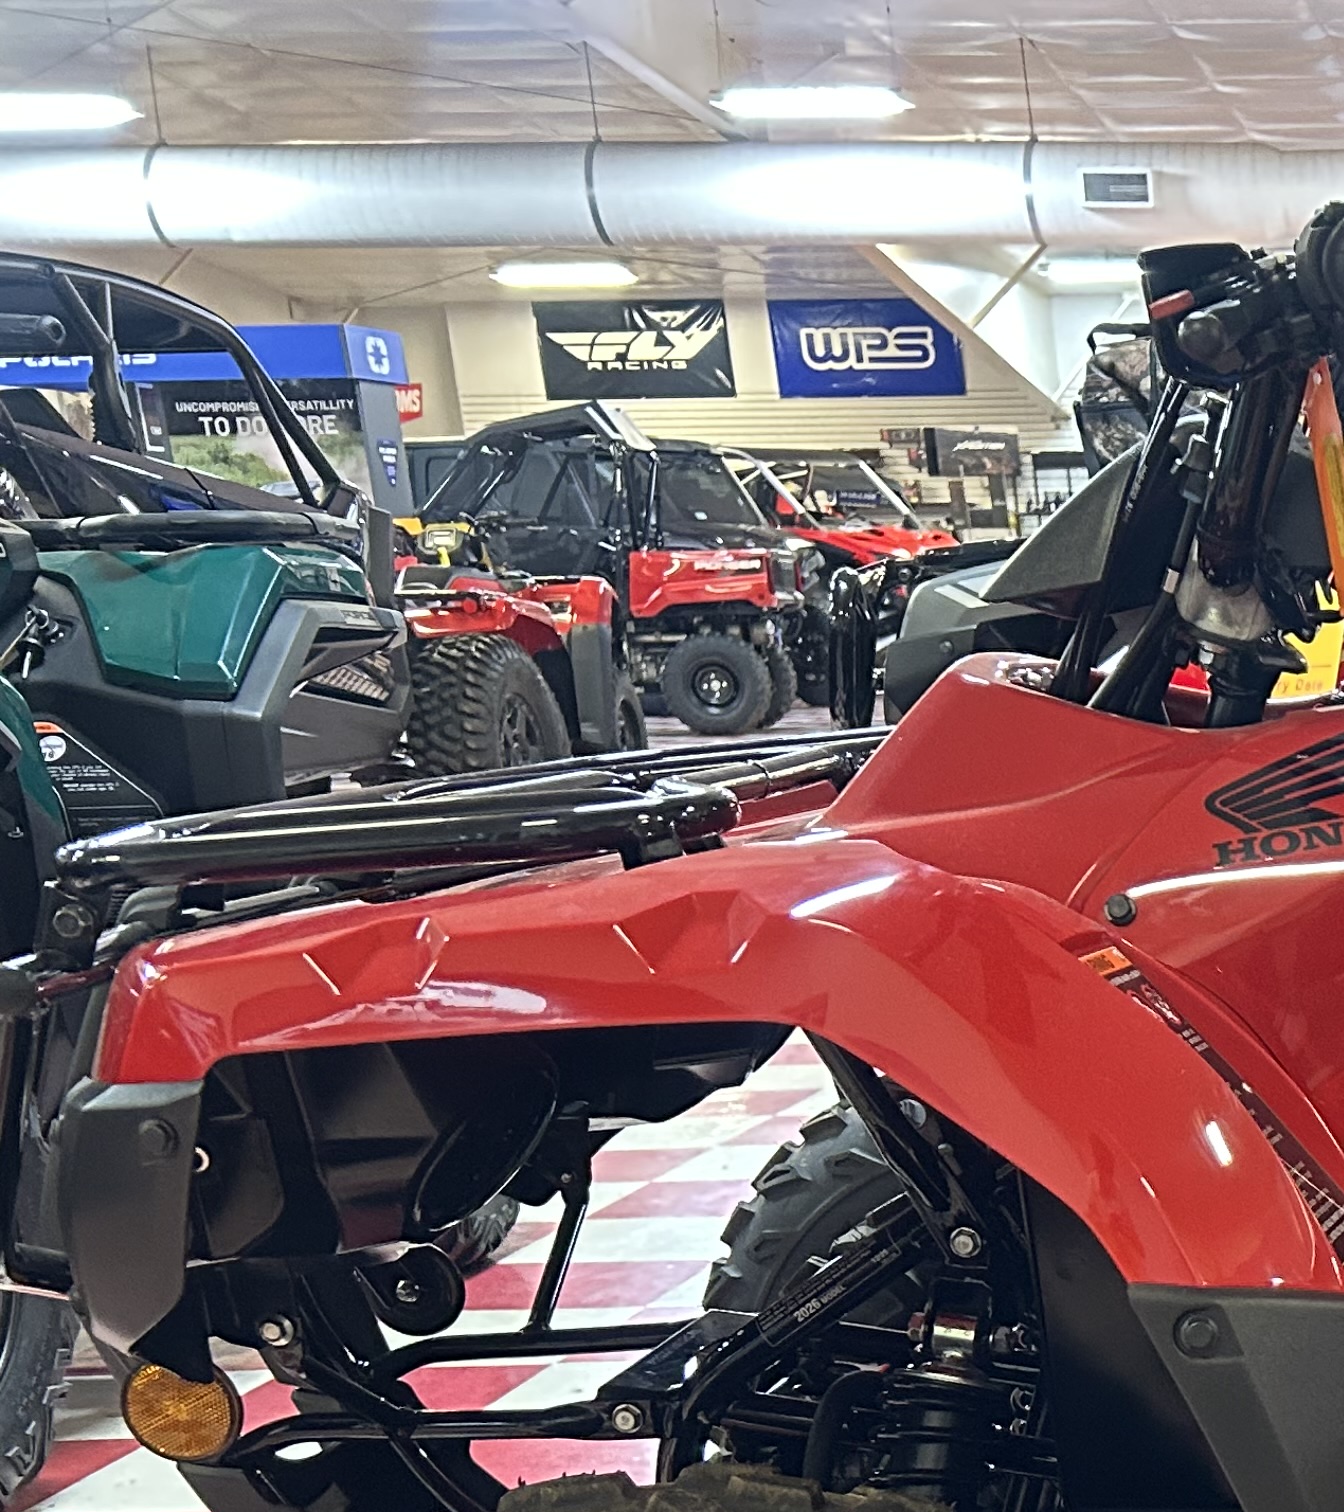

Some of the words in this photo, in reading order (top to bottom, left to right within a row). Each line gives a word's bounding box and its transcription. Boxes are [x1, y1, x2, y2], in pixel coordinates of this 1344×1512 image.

[547, 329, 720, 361] FLY
[799, 326, 936, 371] WPS
[587, 361, 688, 371] RACING
[289, 399, 355, 412] RSATILLITY
[199, 416, 229, 437] TO
[237, 416, 268, 437] DO
[297, 414, 339, 436] RE
